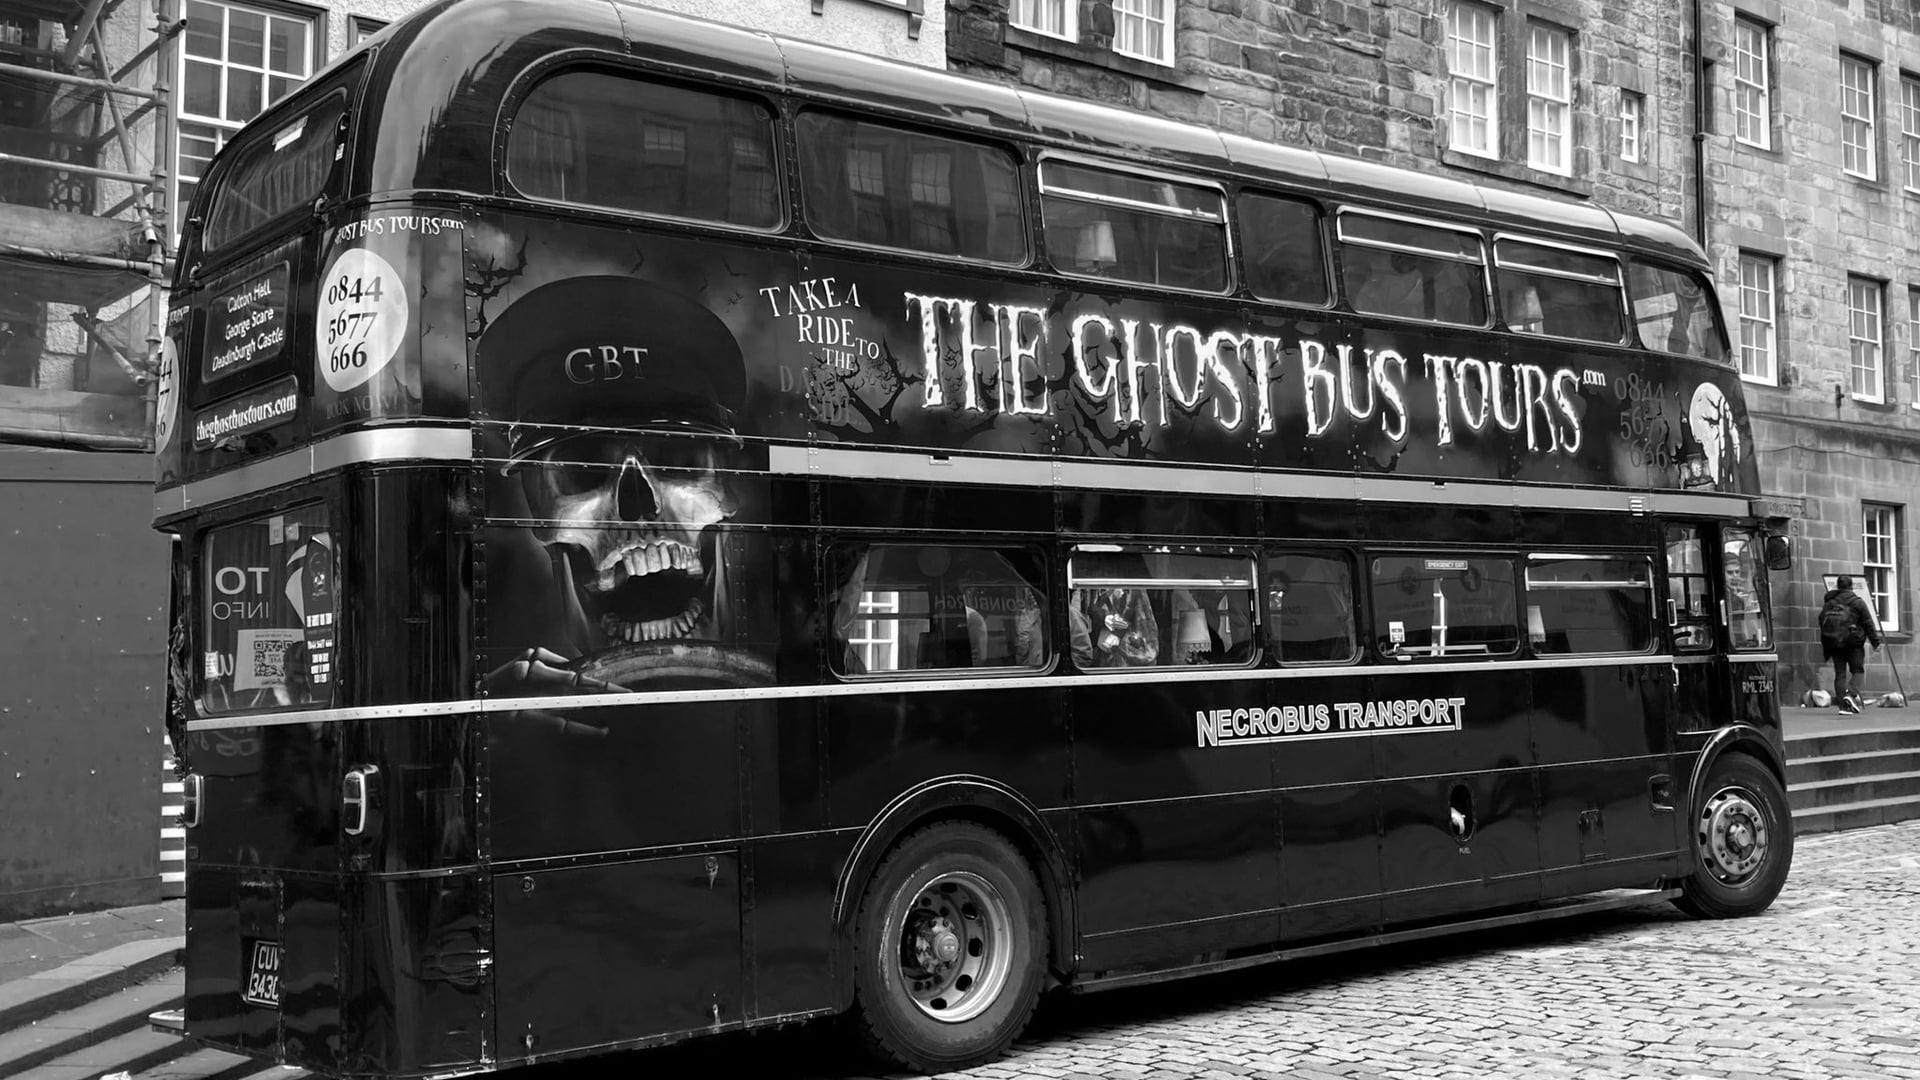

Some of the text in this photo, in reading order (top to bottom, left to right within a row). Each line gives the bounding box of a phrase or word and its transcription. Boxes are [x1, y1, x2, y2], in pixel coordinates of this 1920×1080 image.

[360, 217, 384, 239] BUS
[254, 279, 272, 303] Hell
[328, 275, 384, 305] 0844
[759, 277, 861, 317] TAKE A
[225, 308, 274, 341] George Scare
[328, 309, 378, 345] 5677
[797, 313, 880, 359] RIDE TO
[212, 327, 284, 372] Deadinburgh Castle
[331, 341, 368, 373] 666
[564, 345, 648, 384] GBT
[822, 347, 855, 371] THE
[904, 292, 1054, 416] THE
[1072, 314, 1282, 434] GHOST
[1299, 340, 1408, 442] BUS
[196, 394, 297, 442] theghostbustours.com
[1742, 682, 1757, 693] RML
[1196, 697, 1465, 748] NECROBUS TRANSPORT
